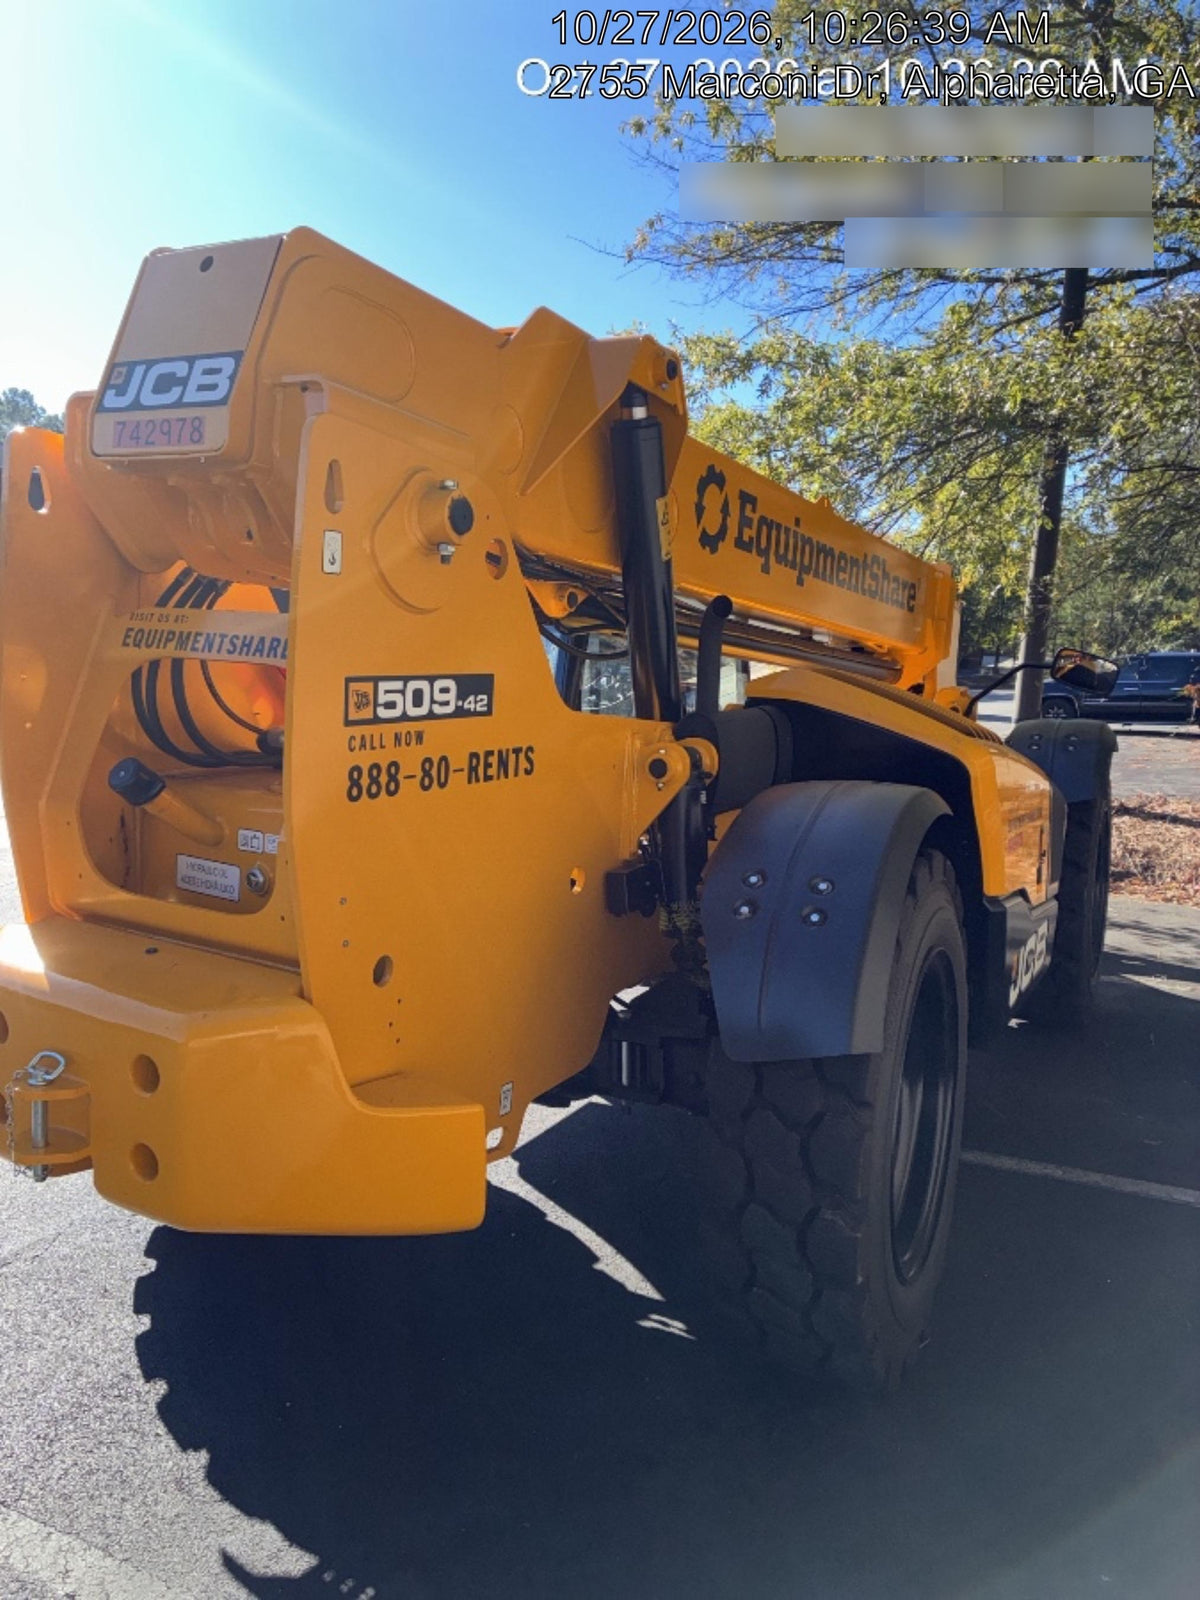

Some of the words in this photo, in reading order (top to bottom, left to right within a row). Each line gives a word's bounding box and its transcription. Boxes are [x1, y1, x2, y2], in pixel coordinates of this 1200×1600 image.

[103, 356, 236, 408] JCB
[116, 416, 204, 446] 742978
[734, 489, 918, 614] EquipmentShare
[347, 732, 387, 753] CALL
[393, 729, 425, 748] NOW
[346, 745, 535, 802] 888-80-RENTS
[1009, 918, 1049, 1009] JCB
